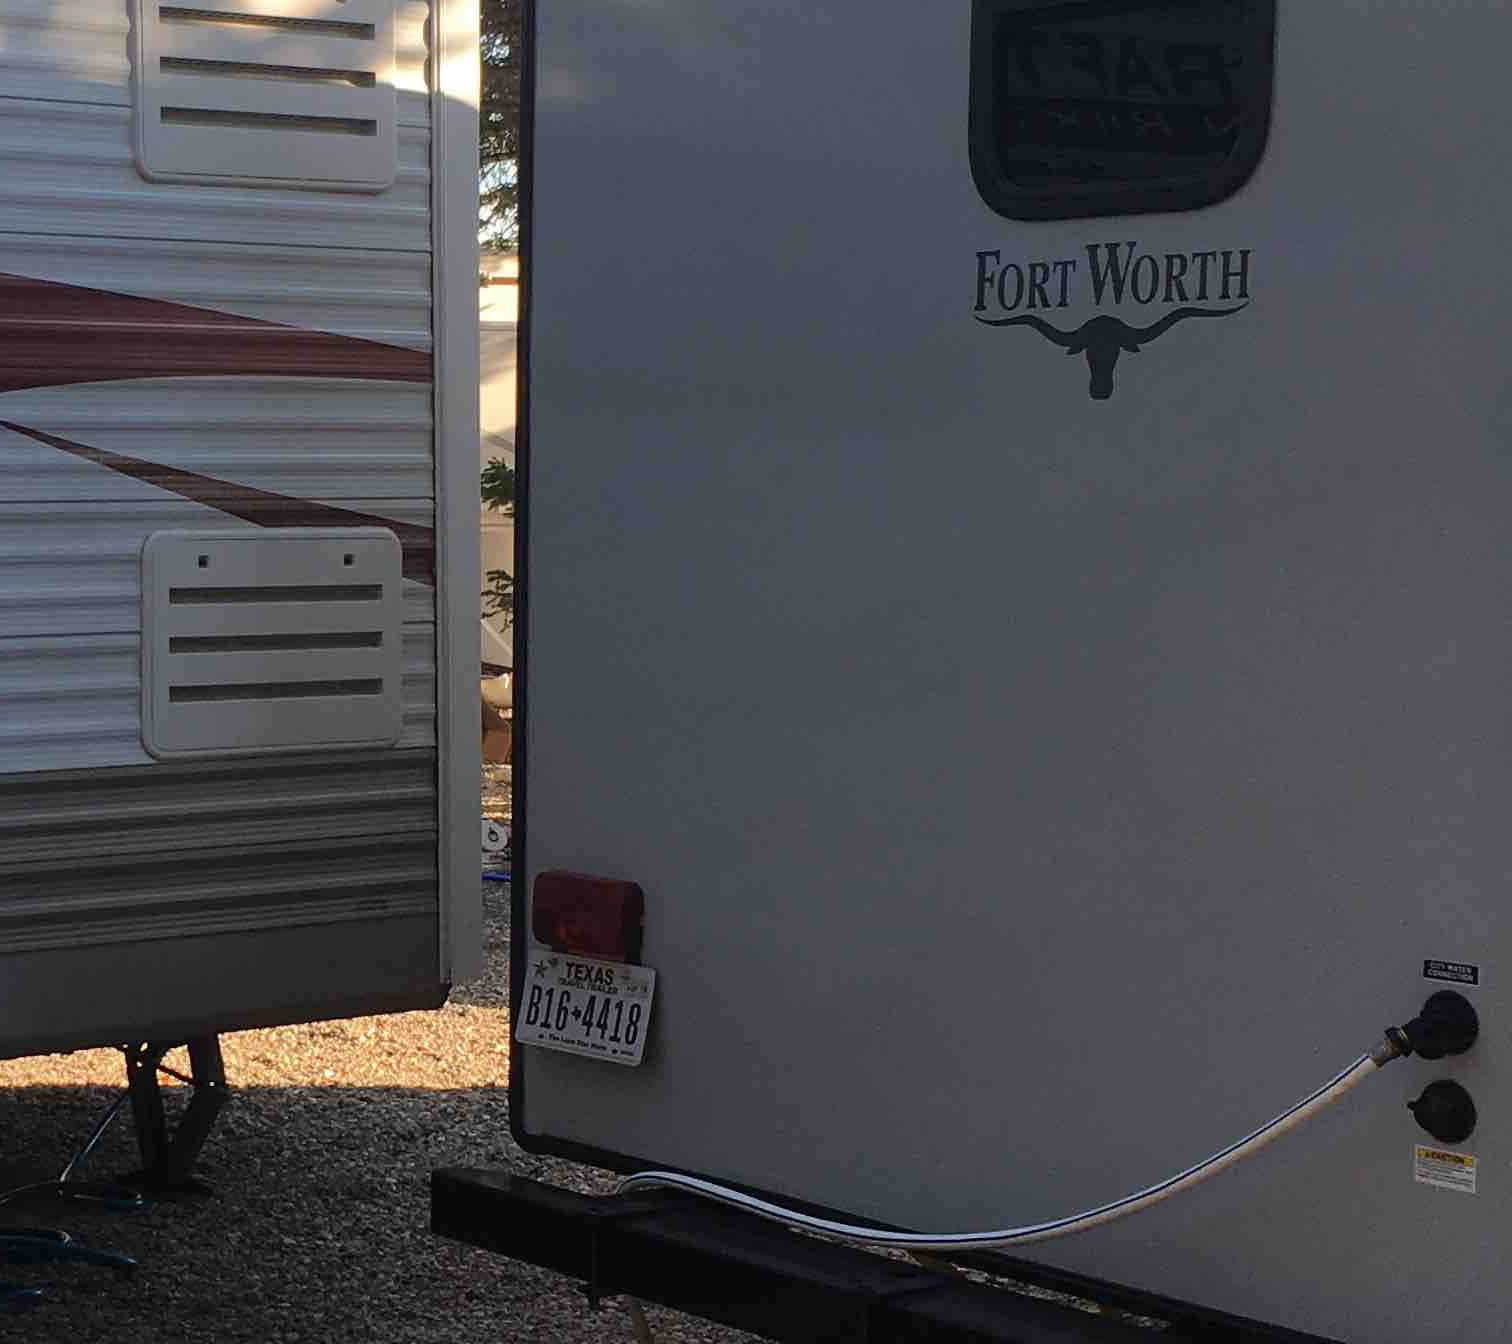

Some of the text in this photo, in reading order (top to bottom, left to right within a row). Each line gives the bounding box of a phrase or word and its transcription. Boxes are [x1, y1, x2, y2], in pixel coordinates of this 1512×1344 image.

[974, 241, 1251, 312] FORT WORTH
[566, 961, 614, 986] TEXAS
